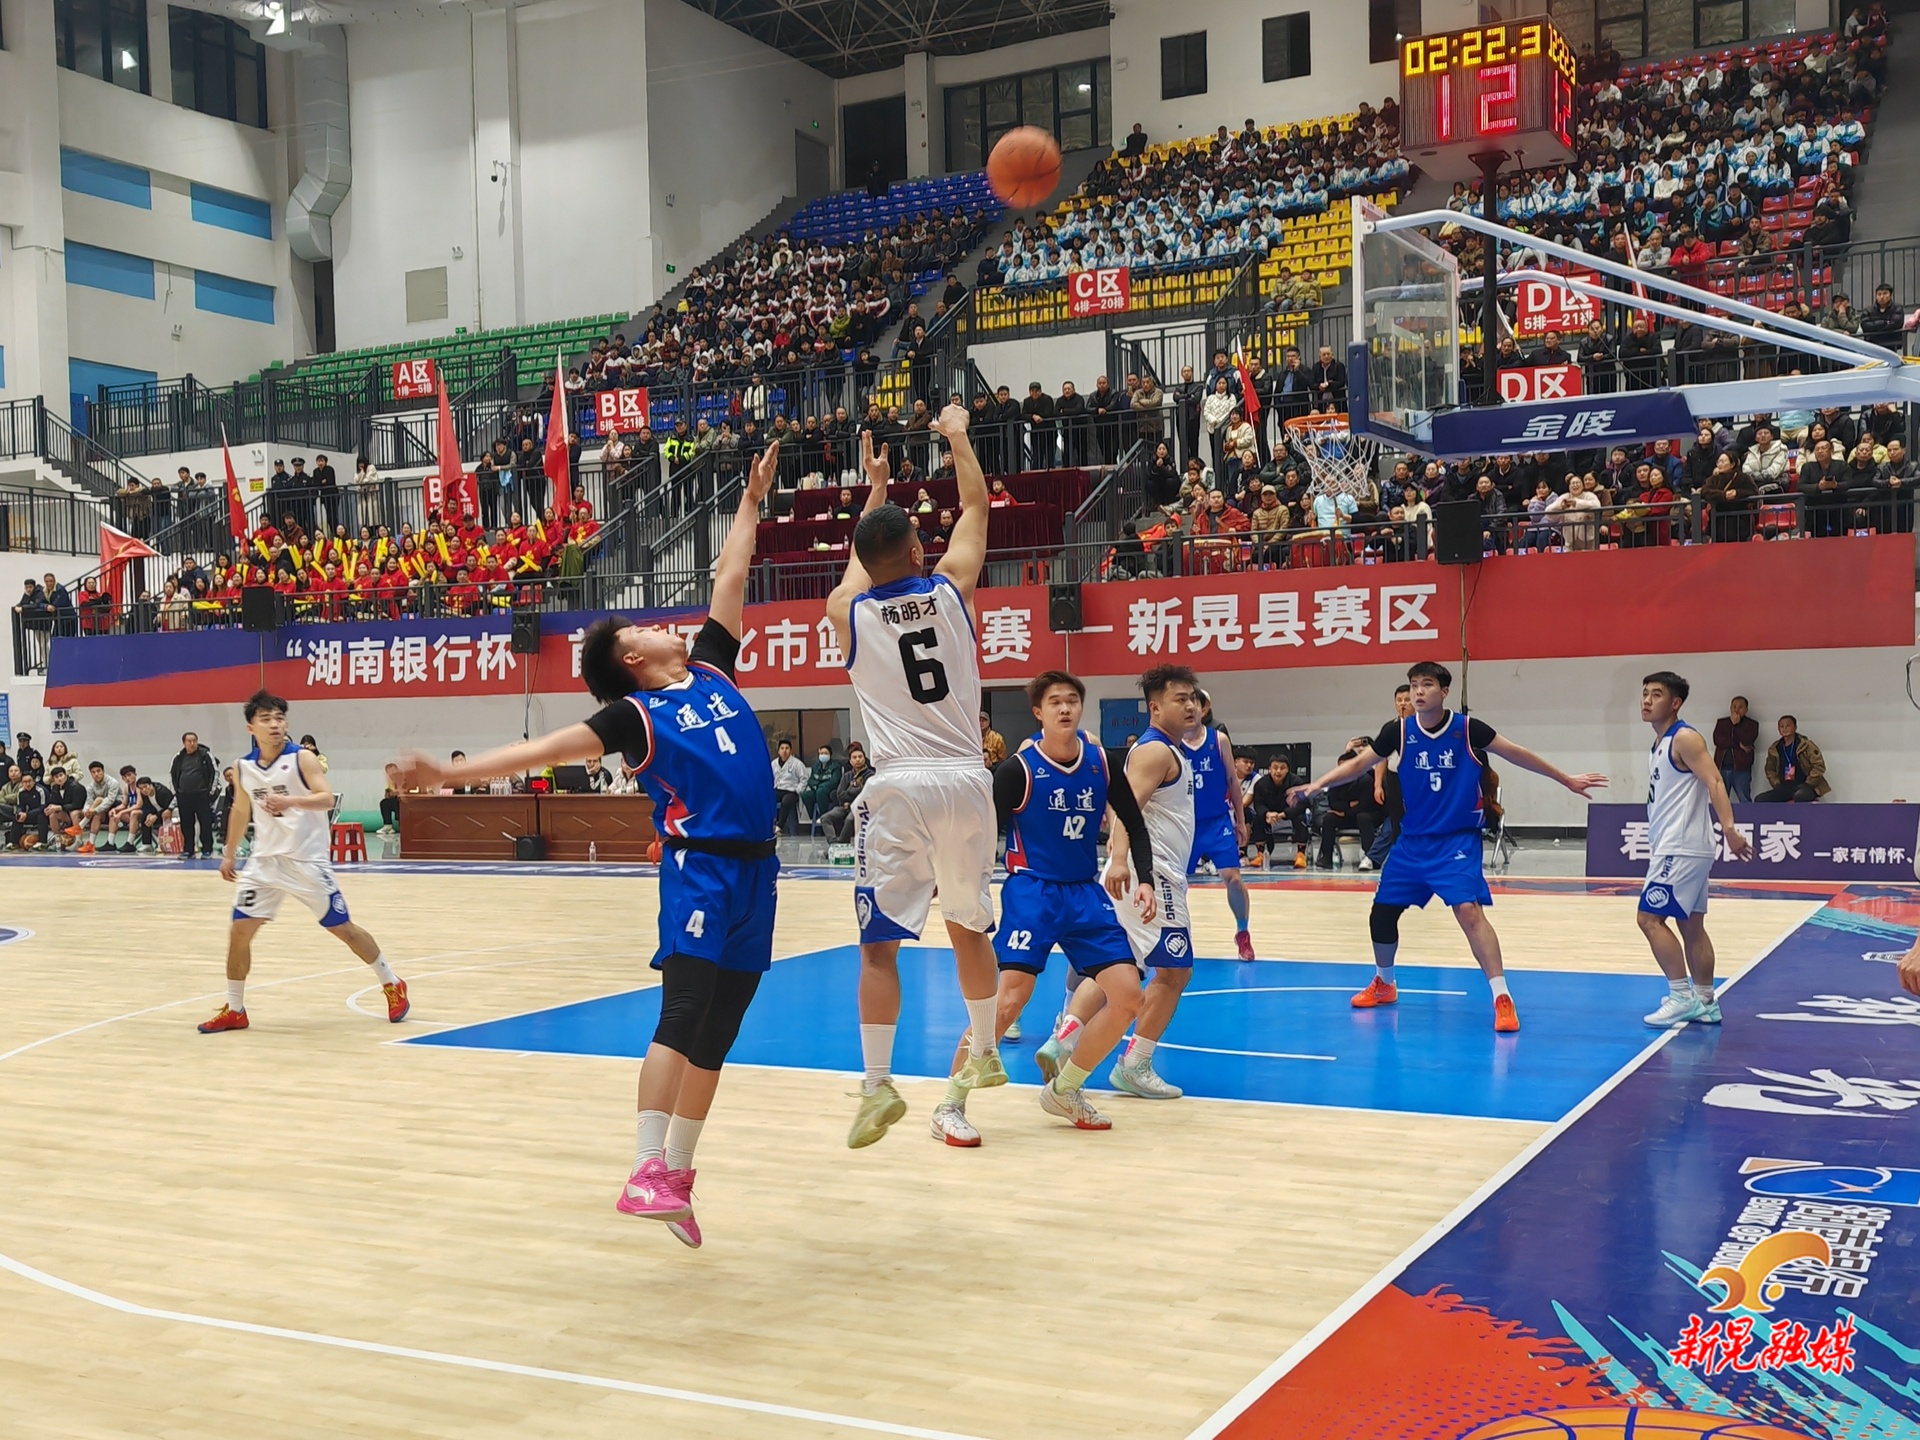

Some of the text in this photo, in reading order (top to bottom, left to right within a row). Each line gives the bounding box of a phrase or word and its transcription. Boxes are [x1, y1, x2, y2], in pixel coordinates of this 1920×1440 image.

[1405, 25, 1541, 77] 02:22.3
[1440, 63, 1518, 138] 12
[1554, 69, 1572, 147] 12
[1076, 268, 1122, 298] C区
[1527, 276, 1593, 313] D区
[398, 360, 431, 385] A区
[1501, 366, 1570, 403] D区
[601, 389, 642, 418] B区
[1505, 409, 1632, 443] 金陵
[880, 595, 938, 626] 杨明才
[1127, 584, 1439, 655] 新晃县赛区
[898, 626, 950, 705] 6
[676, 692, 739, 732] 通道
[714, 725, 737, 755] 4
[1415, 748, 1456, 770] 通道
[1429, 771, 1442, 792] 5
[1048, 787, 1096, 812] 通道
[1062, 815, 1086, 840] 42
[1620, 822, 1802, 862] 君酒家
[685, 910, 705, 938] 4
[1007, 930, 1032, 951] 42
